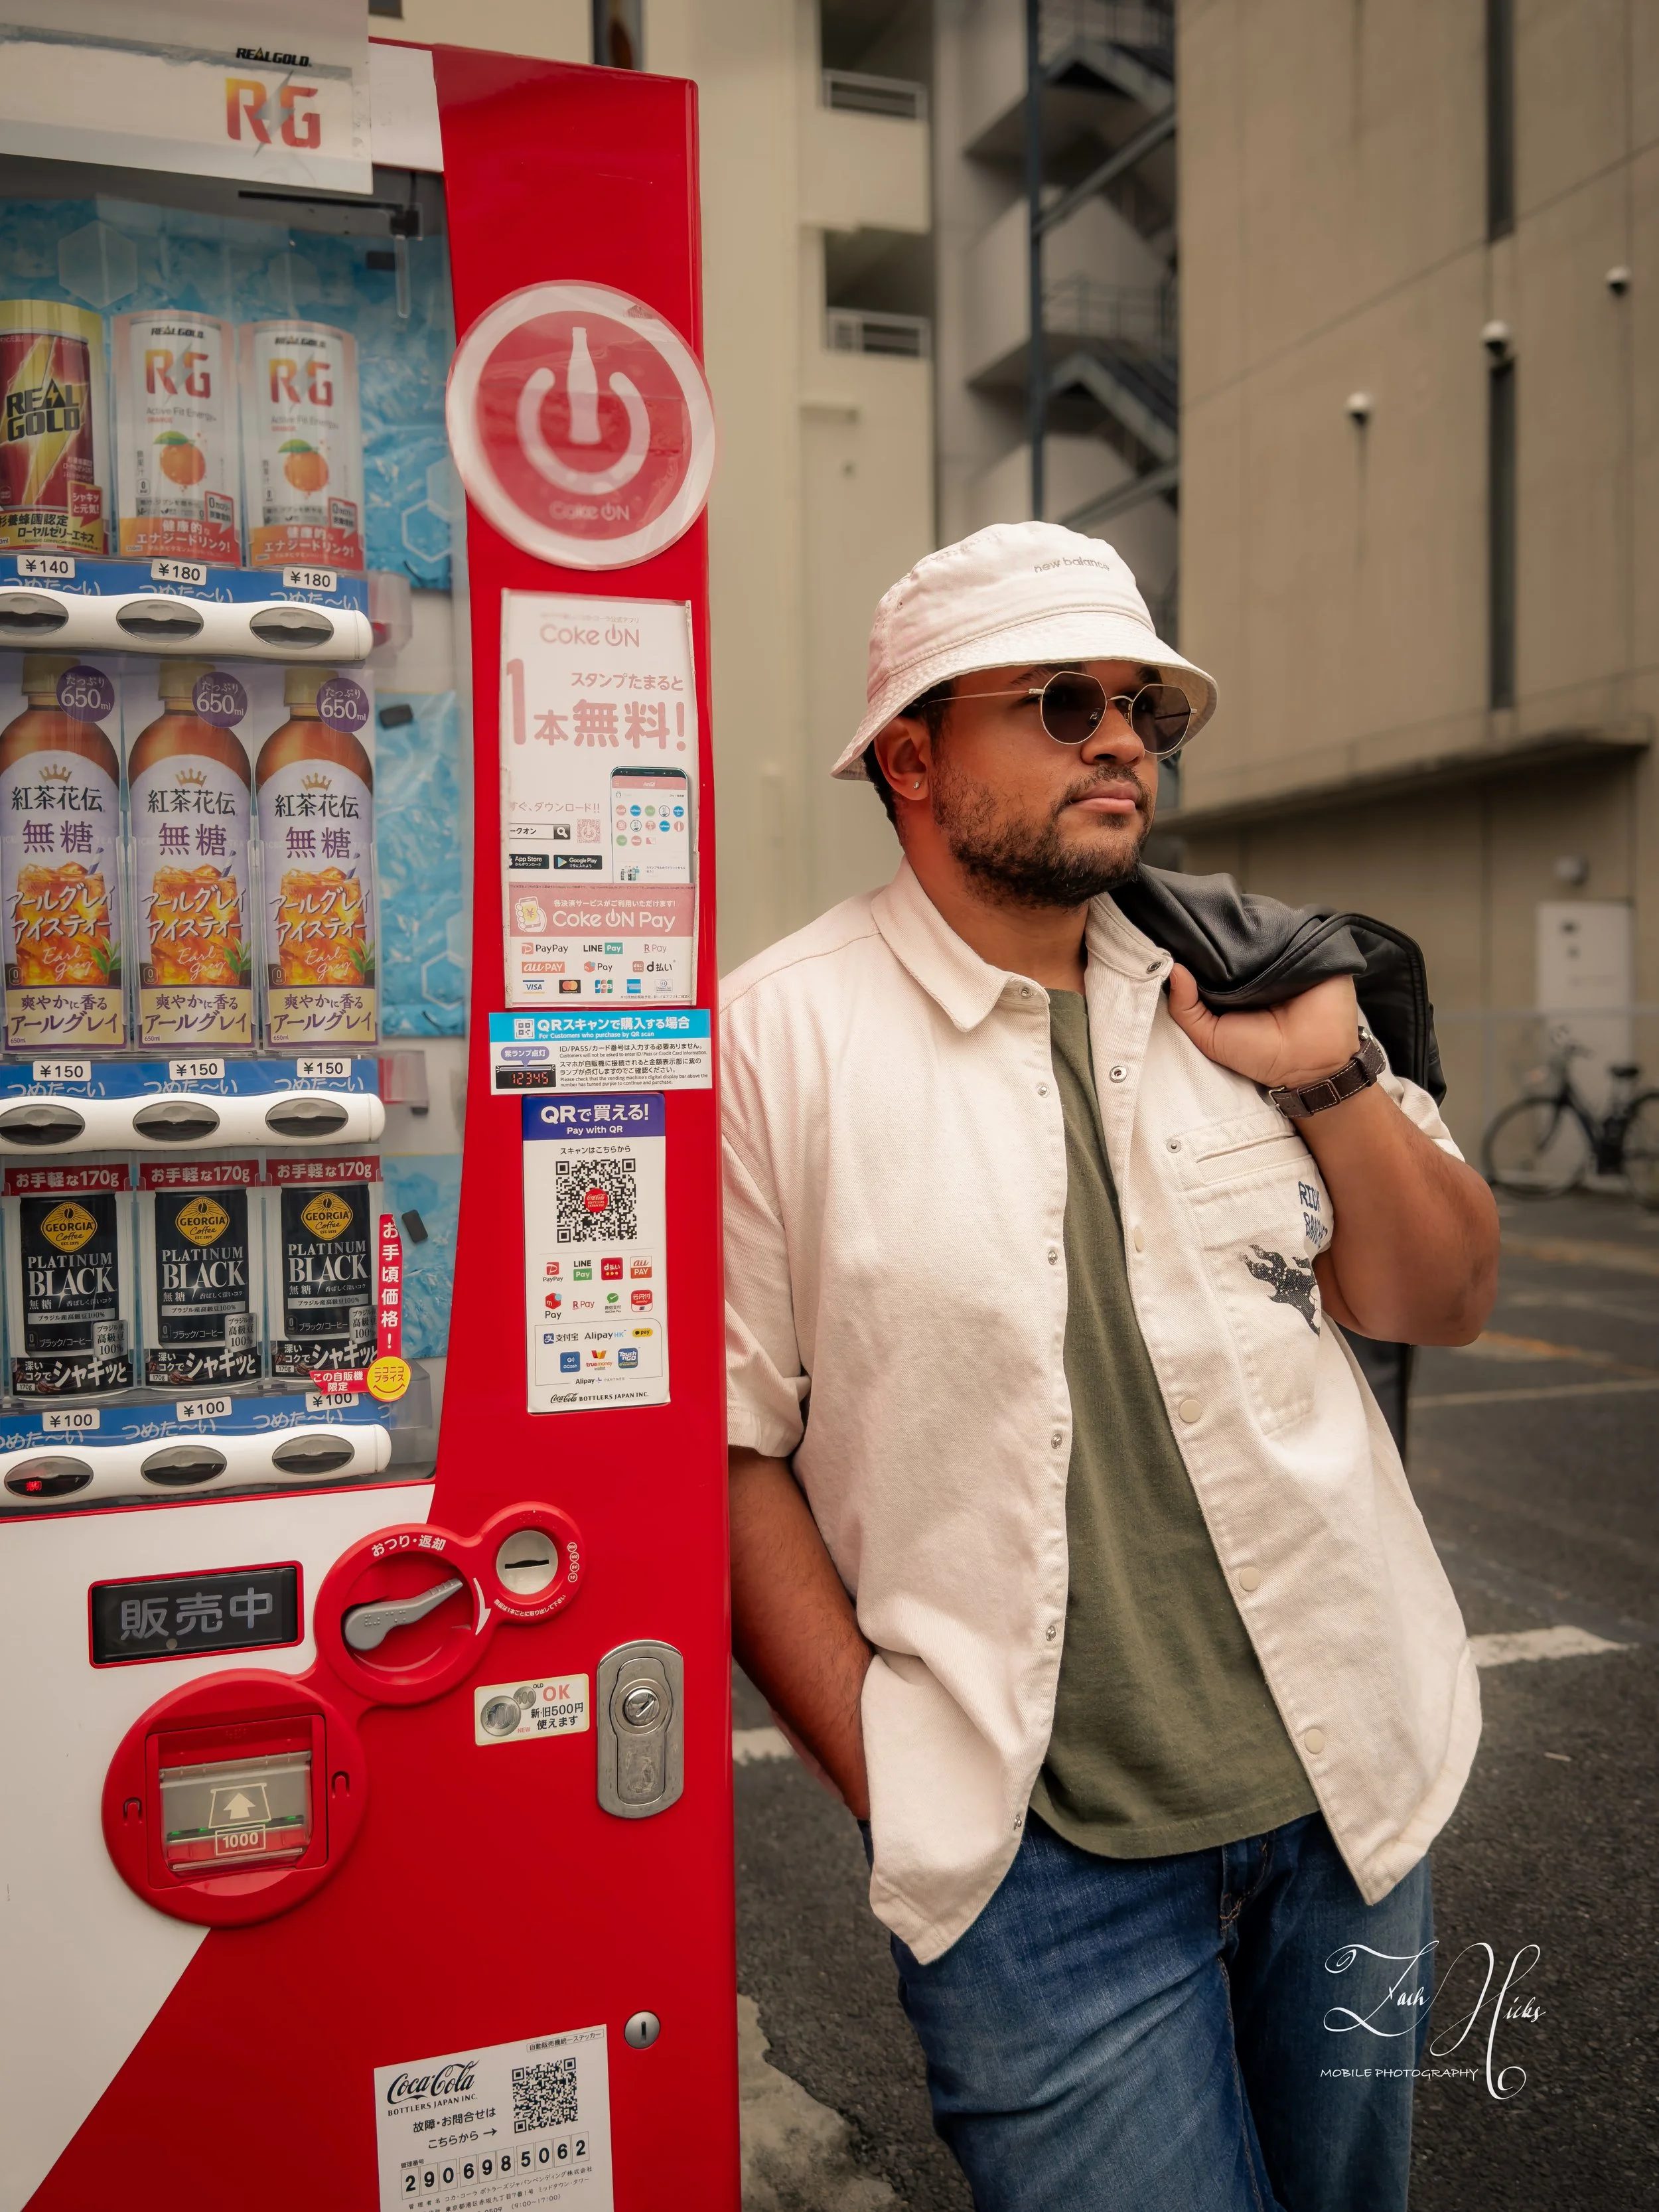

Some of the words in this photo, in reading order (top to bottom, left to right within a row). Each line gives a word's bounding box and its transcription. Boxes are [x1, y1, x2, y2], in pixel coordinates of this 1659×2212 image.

[236, 47, 310, 67] REALGOLD
[226, 78, 321, 149] RG
[145, 349, 211, 399] RG
[269, 359, 333, 407] RG
[7, 378, 80, 418] REAL
[7, 407, 80, 441] GOLD
[72, 492, 100, 502] シャキッ
[549, 501, 599, 520] Coke
[601, 501, 630, 522] ON
[18, 526, 94, 543] ローヤルゼリーエキス
[137, 533, 230, 553] エナジードリンク!
[26, 559, 68, 573] ¥140
[159, 563, 200, 581] ¥180
[1033, 559, 1060, 573] new
[1062, 556, 1110, 571] balance
[291, 571, 330, 587] ¥180
[540, 623, 600, 646] Coke
[605, 624, 639, 647] ON
[66, 674, 105, 688] たっぷり
[571, 672, 684, 692] スタンプたまると
[506, 658, 686, 751] 1本無料!
[12, 785, 103, 812] 紅茶花伝
[147, 788, 236, 816] 紅茶花伝
[274, 793, 359, 819] 紅茶花伝
[23, 820, 93, 853] 無糖
[158, 823, 226, 856] 無糖
[285, 827, 351, 859] 無糖
[6, 882, 115, 919] アールグレイ
[141, 884, 246, 919] アールグレイ
[553, 899, 676, 908] 各決済サービスがご利用いただけます!
[553, 911, 602, 927] Coke
[605, 909, 634, 927] ON
[640, 911, 676, 932] Pay
[11, 915, 111, 944] アイスティー
[147, 917, 243, 945] アイスティー
[42, 944, 82, 964] Earl
[536, 944, 569, 954] PayPay
[597, 963, 613, 972] Pay
[646, 961, 672, 972] d払い
[21, 994, 108, 1011] 爽やかに香る
[156, 994, 238, 1009] 爽やかに香る
[11, 1011, 117, 1035] アールグレイ
[145, 1010, 246, 1033] アールグレイ
[274, 1009, 372, 1033] アールグレイ
[538, 1016, 690, 1031] QRスキャンで購入する場合
[40, 1065, 83, 1078] ¥150
[176, 1063, 217, 1076] ¥150
[304, 1063, 343, 1074] ¥150
[512, 1072, 549, 1085] 12345
[541, 1103, 649, 1124] QRで買える!
[560, 1145, 631, 1155] スキャンはこちらから
[151, 1165, 250, 1183] お手軽な170g
[277, 1161, 372, 1178] お手軽な170g
[16, 1170, 119, 1189] お手軽な170g
[46, 1222, 94, 1232] GEORGIA
[180, 1217, 226, 1226] GEORGIA
[56, 1232, 84, 1241] Coffee
[190, 1226, 217, 1236] Coffee
[162, 1246, 243, 1262] PLATINUM
[288, 1240, 366, 1256] PLATINUM
[28, 1252, 112, 1269] PLATINUM
[288, 1254, 368, 1283] BLACK
[28, 1266, 116, 1297] BLACK
[163, 1260, 246, 1290] BLACK
[67, 1297, 112, 1307] 香ばしく深いコク
[38, 1311, 105, 1321] ブラジル産高級豆100%
[39, 1338, 92, 1348] ブラック/コーヒー
[173, 1330, 224, 1339] ブラック/コーヒー
[555, 1333, 579, 1343] 支付宝
[158, 1352, 175, 1361] 深い
[186, 1349, 255, 1378] シャキッと
[25, 1361, 42, 1370] 深い
[54, 1357, 127, 1388] シャキッと
[159, 1363, 184, 1372] コクで
[26, 1372, 50, 1380] コクで
[313, 1371, 363, 1382] この自販機
[328, 1382, 348, 1392] 限定
[550, 1392, 579, 1404] Coca-Cola
[184, 1401, 224, 1417] ¥100
[50, 1414, 93, 1428] ¥100
[26, 1481, 42, 1491] 売切
[371, 1534, 446, 1557] おつり・返却
[121, 1587, 273, 1641] 販売中
[543, 1684, 570, 1702] OK
[537, 1716, 578, 1730] 使えます
[222, 1832, 259, 1849] 1000
[529, 2032, 602, 2051] 自動販売機統一ステッカー
[387, 2059, 480, 2104] Coca-Cola
[388, 2102, 431, 2116] BOTTLERS
[433, 2097, 459, 2108] JAPAN
[462, 2093, 478, 2102] INC.
[413, 2107, 496, 2132] 故障・お問合せは
[428, 2130, 478, 2149] こちらから
[401, 2159, 424, 2168] 管理番号
